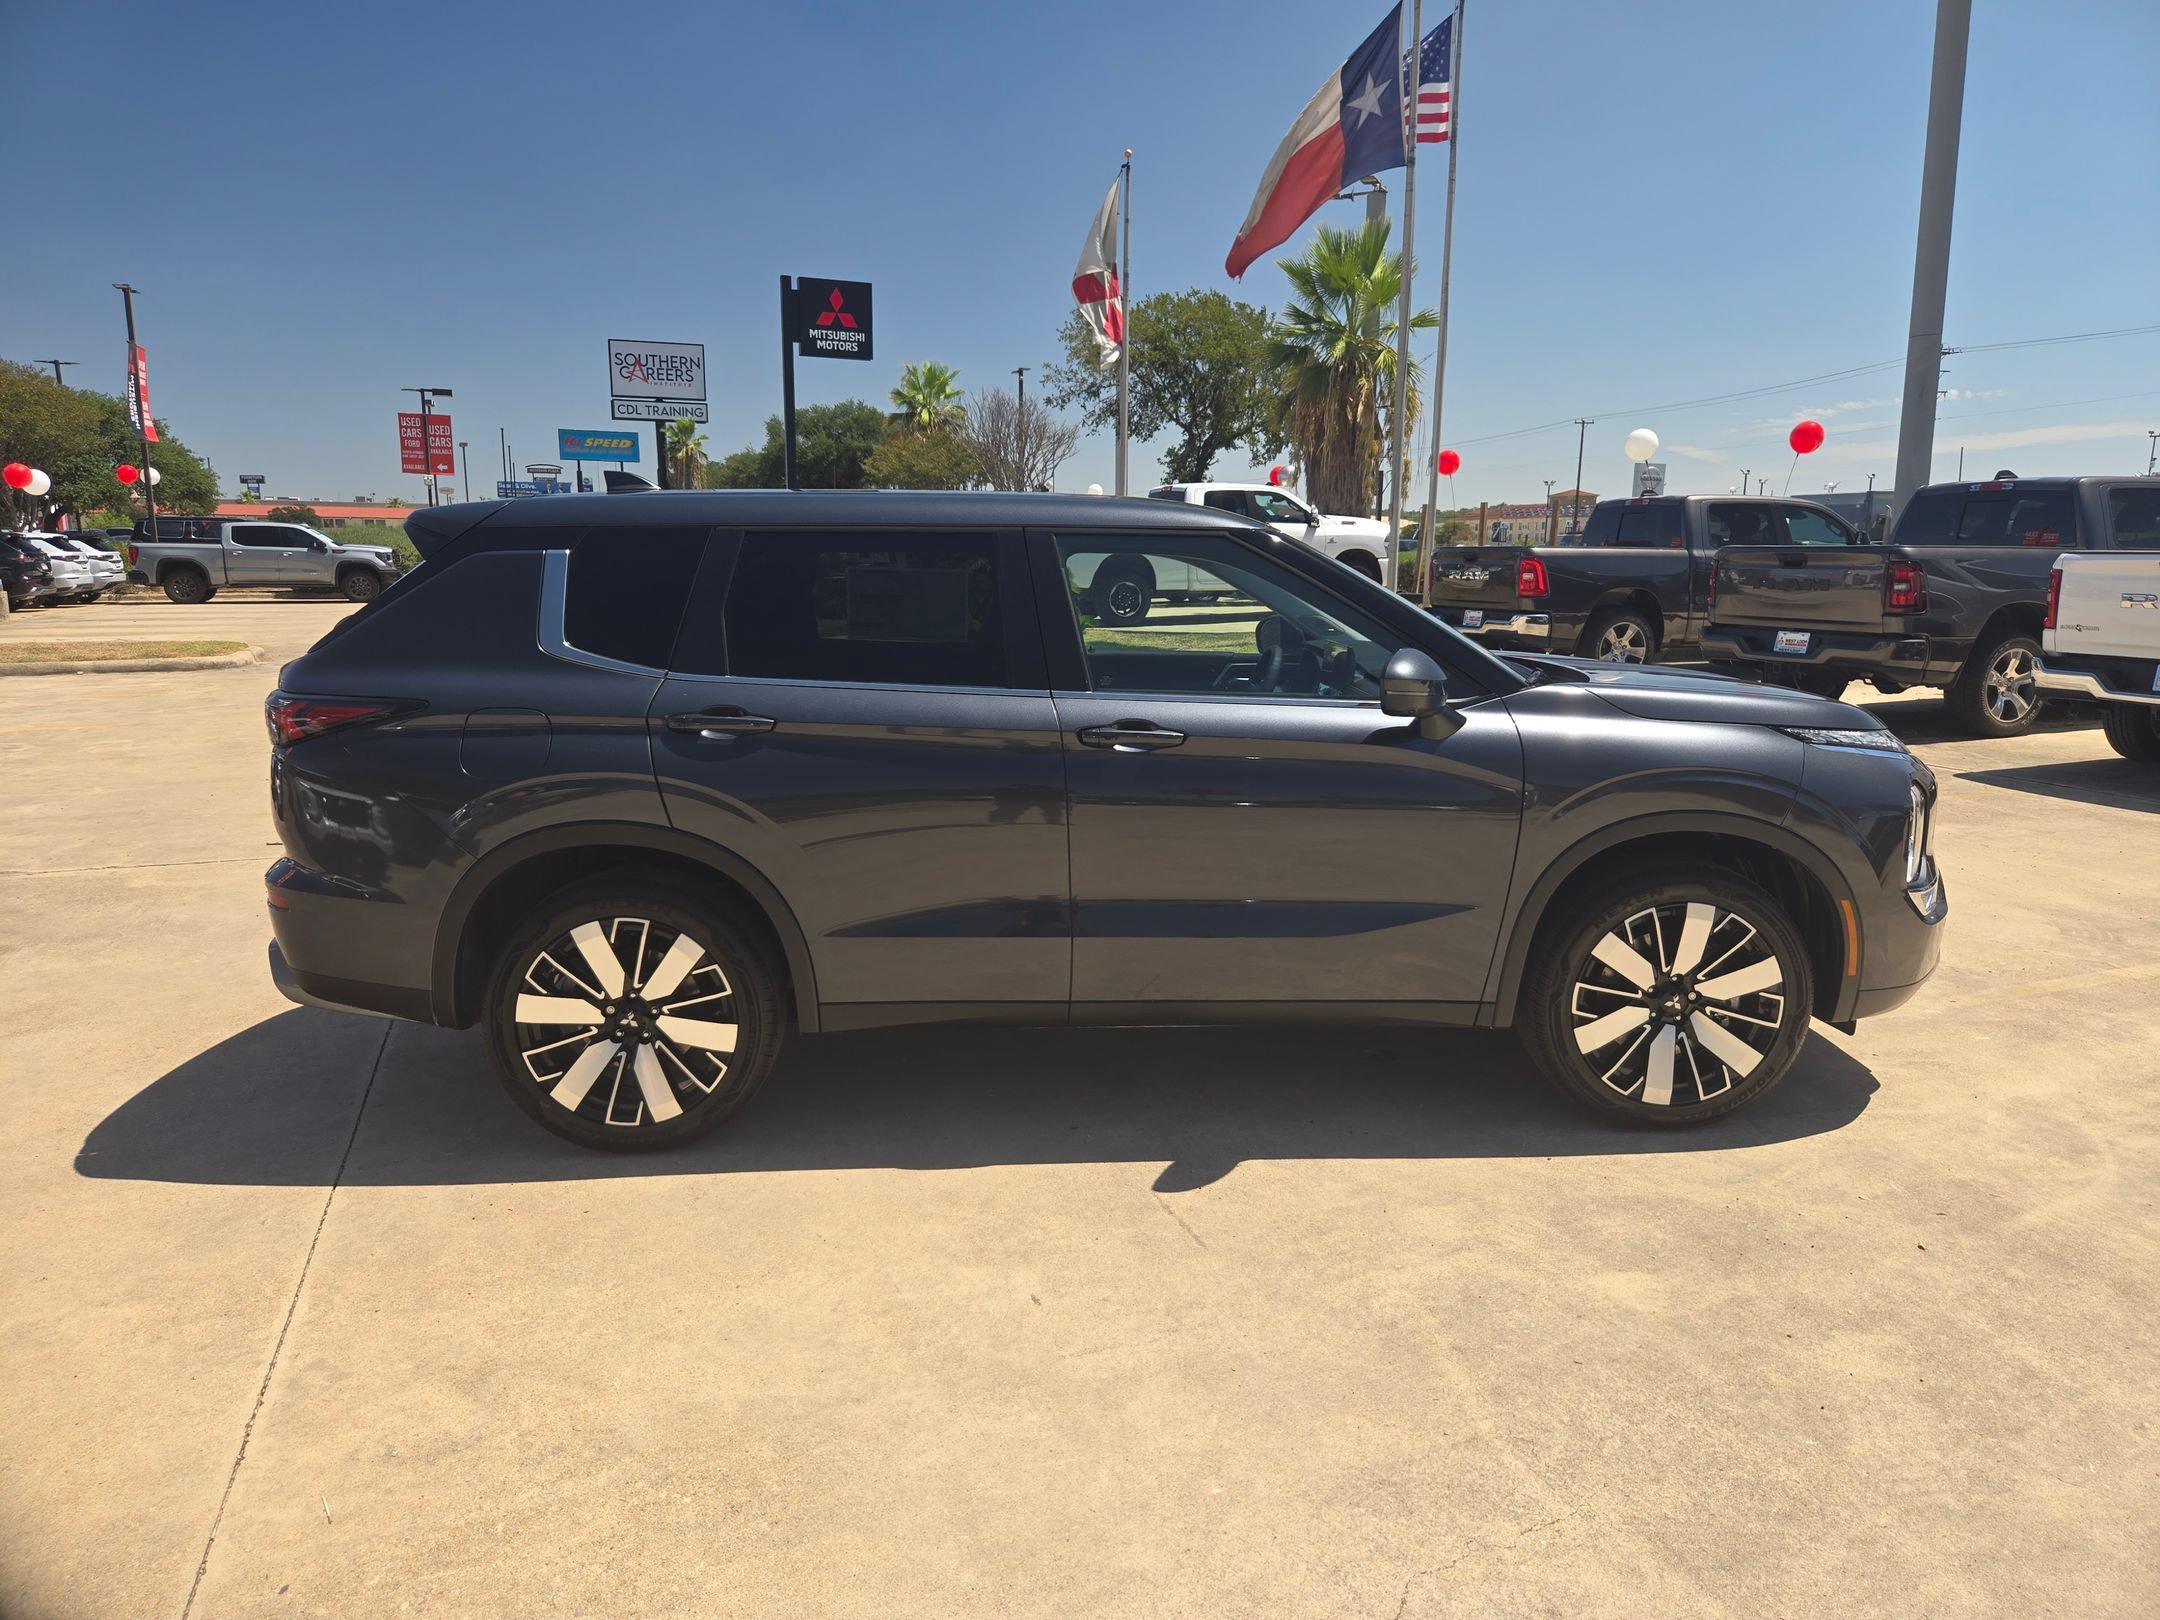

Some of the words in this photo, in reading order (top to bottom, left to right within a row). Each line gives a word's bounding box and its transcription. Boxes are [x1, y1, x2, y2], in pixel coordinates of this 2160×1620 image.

[809, 329, 865, 342] MITSUBISHI
[817, 340, 858, 351] MOTORS
[614, 352, 701, 369] SOUTHERN
[619, 358, 694, 383] CAREERS
[617, 404, 642, 415] CDL
[645, 405, 704, 417] TRAINING
[400, 417, 421, 427] USED
[401, 428, 422, 438] CARS
[428, 425, 451, 436] USED
[404, 440, 421, 448] FORD
[429, 437, 452, 447] CARS
[584, 438, 634, 448] SPEED
